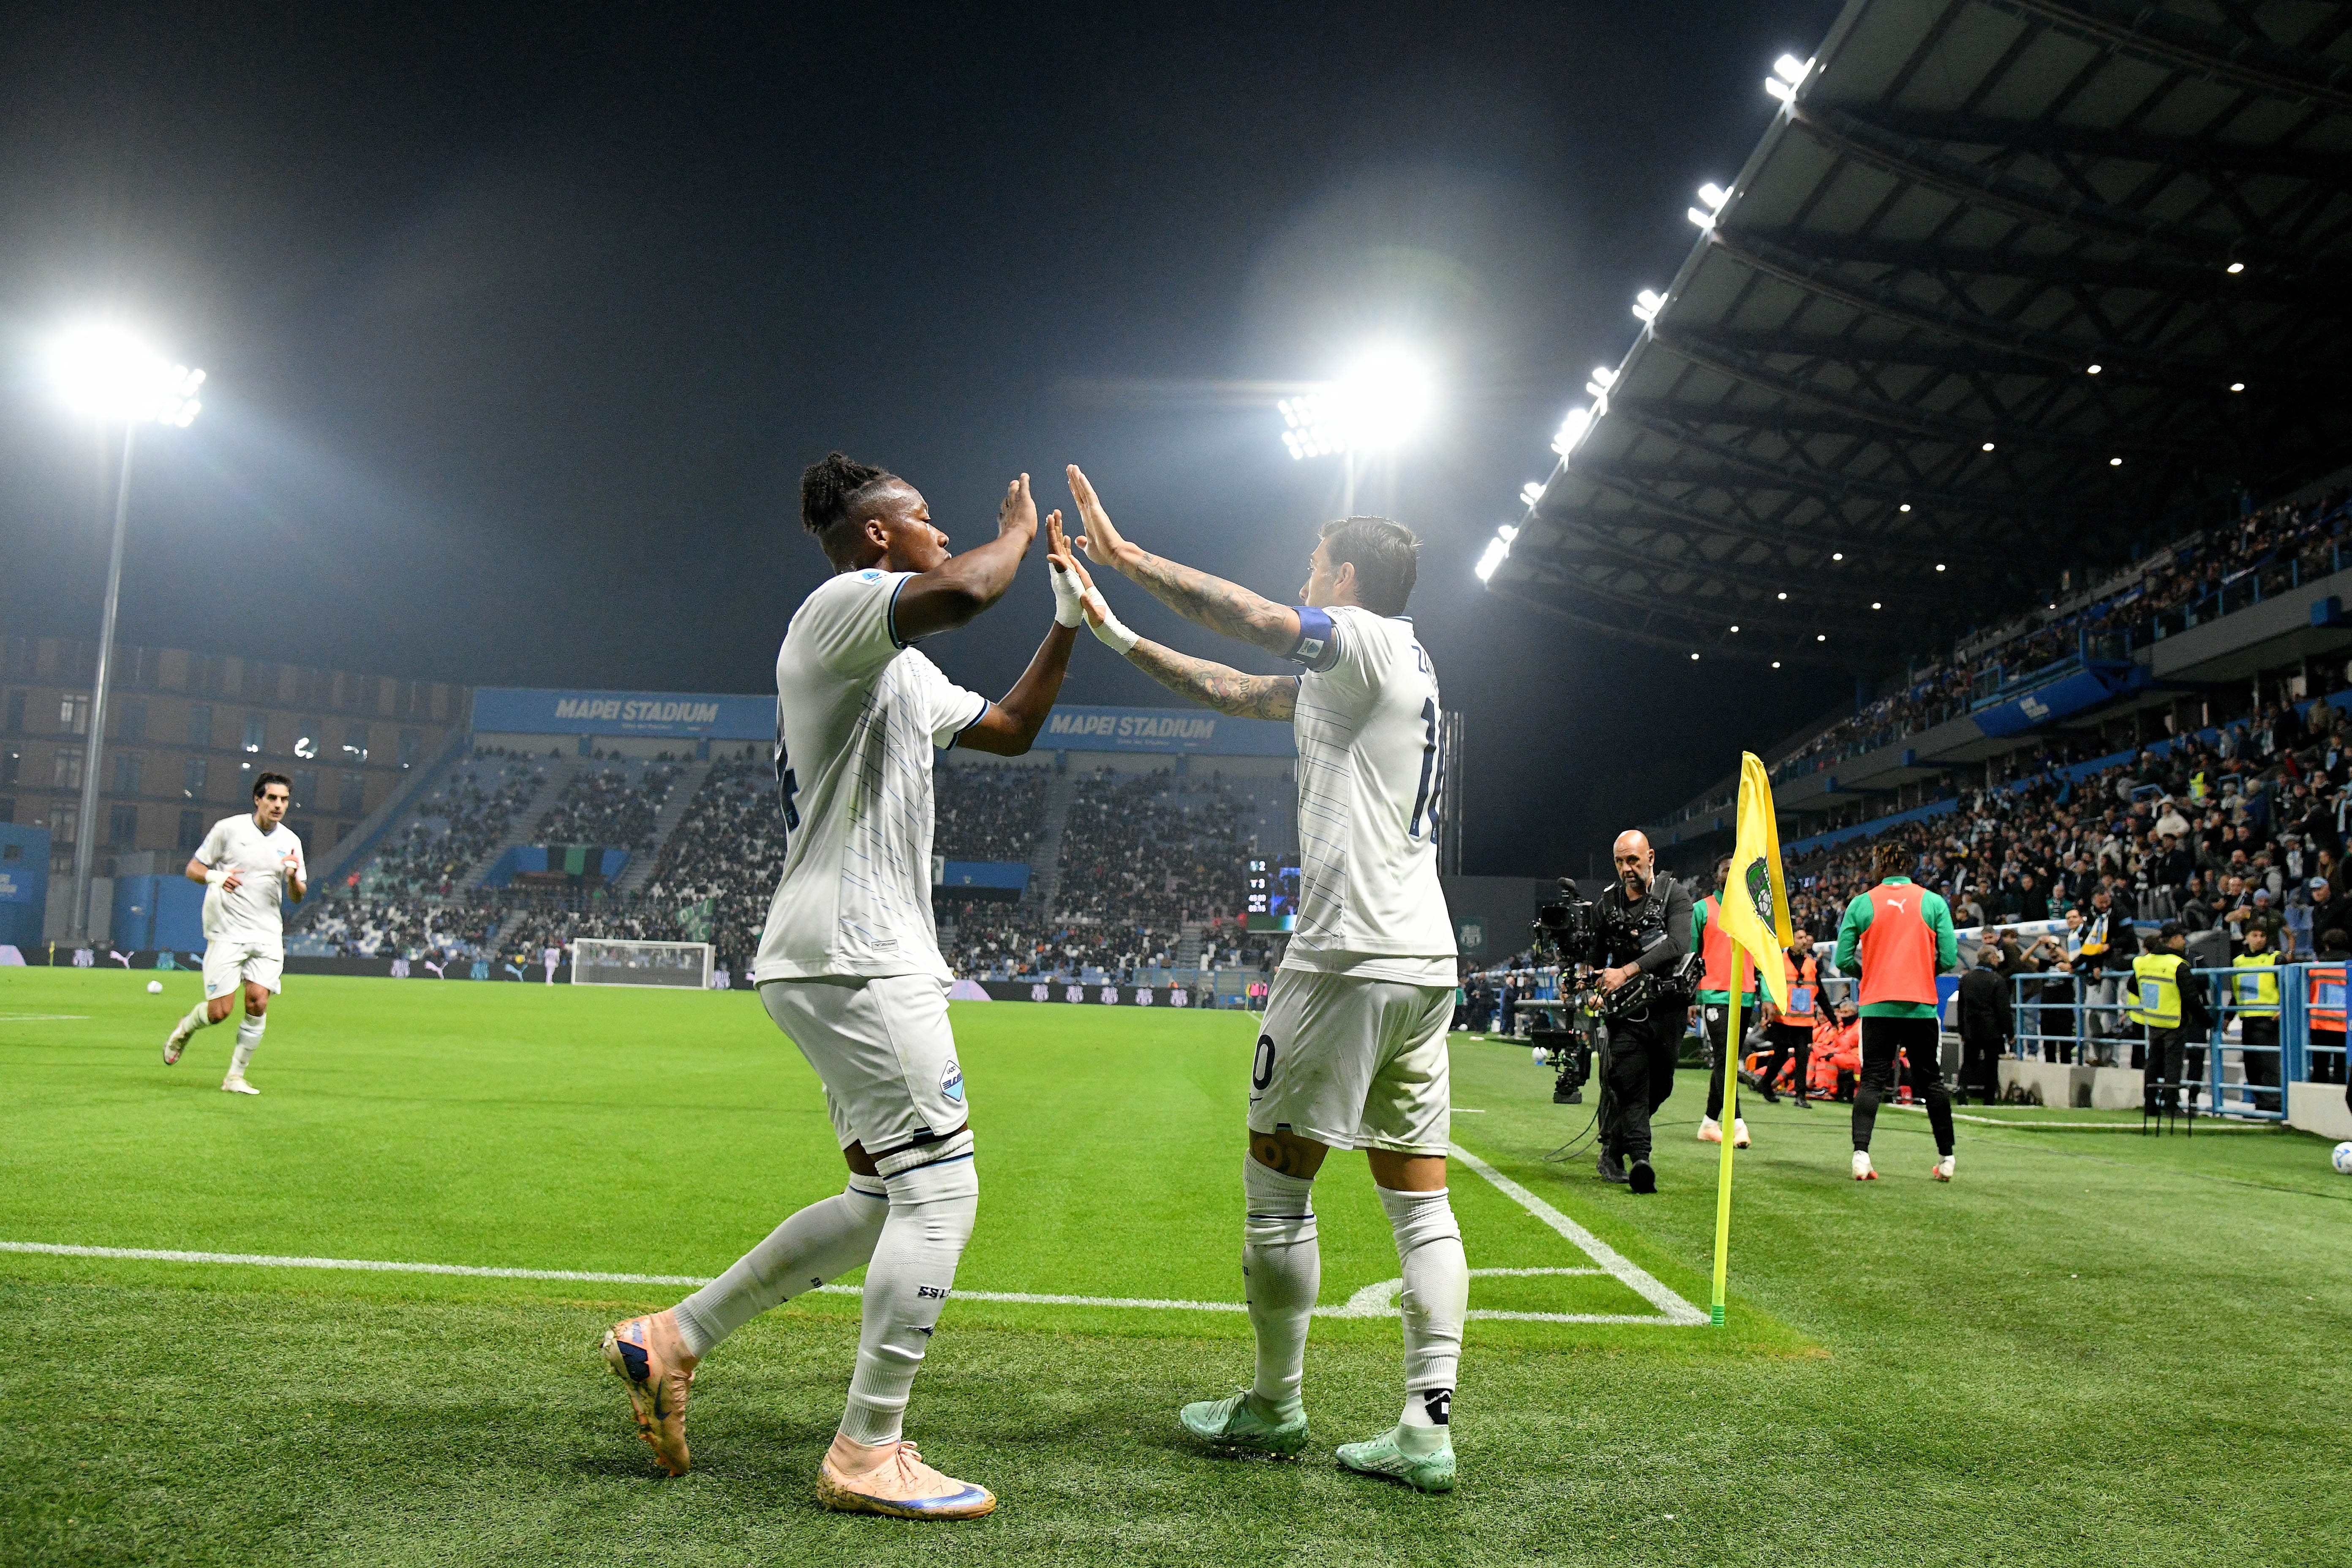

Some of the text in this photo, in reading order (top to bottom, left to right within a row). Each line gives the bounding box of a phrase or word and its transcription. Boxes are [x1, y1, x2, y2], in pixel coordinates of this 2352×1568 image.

[556, 700, 718, 723] MAPEI STADIUM
[1049, 714, 1216, 739] MAPEI STADIUM
